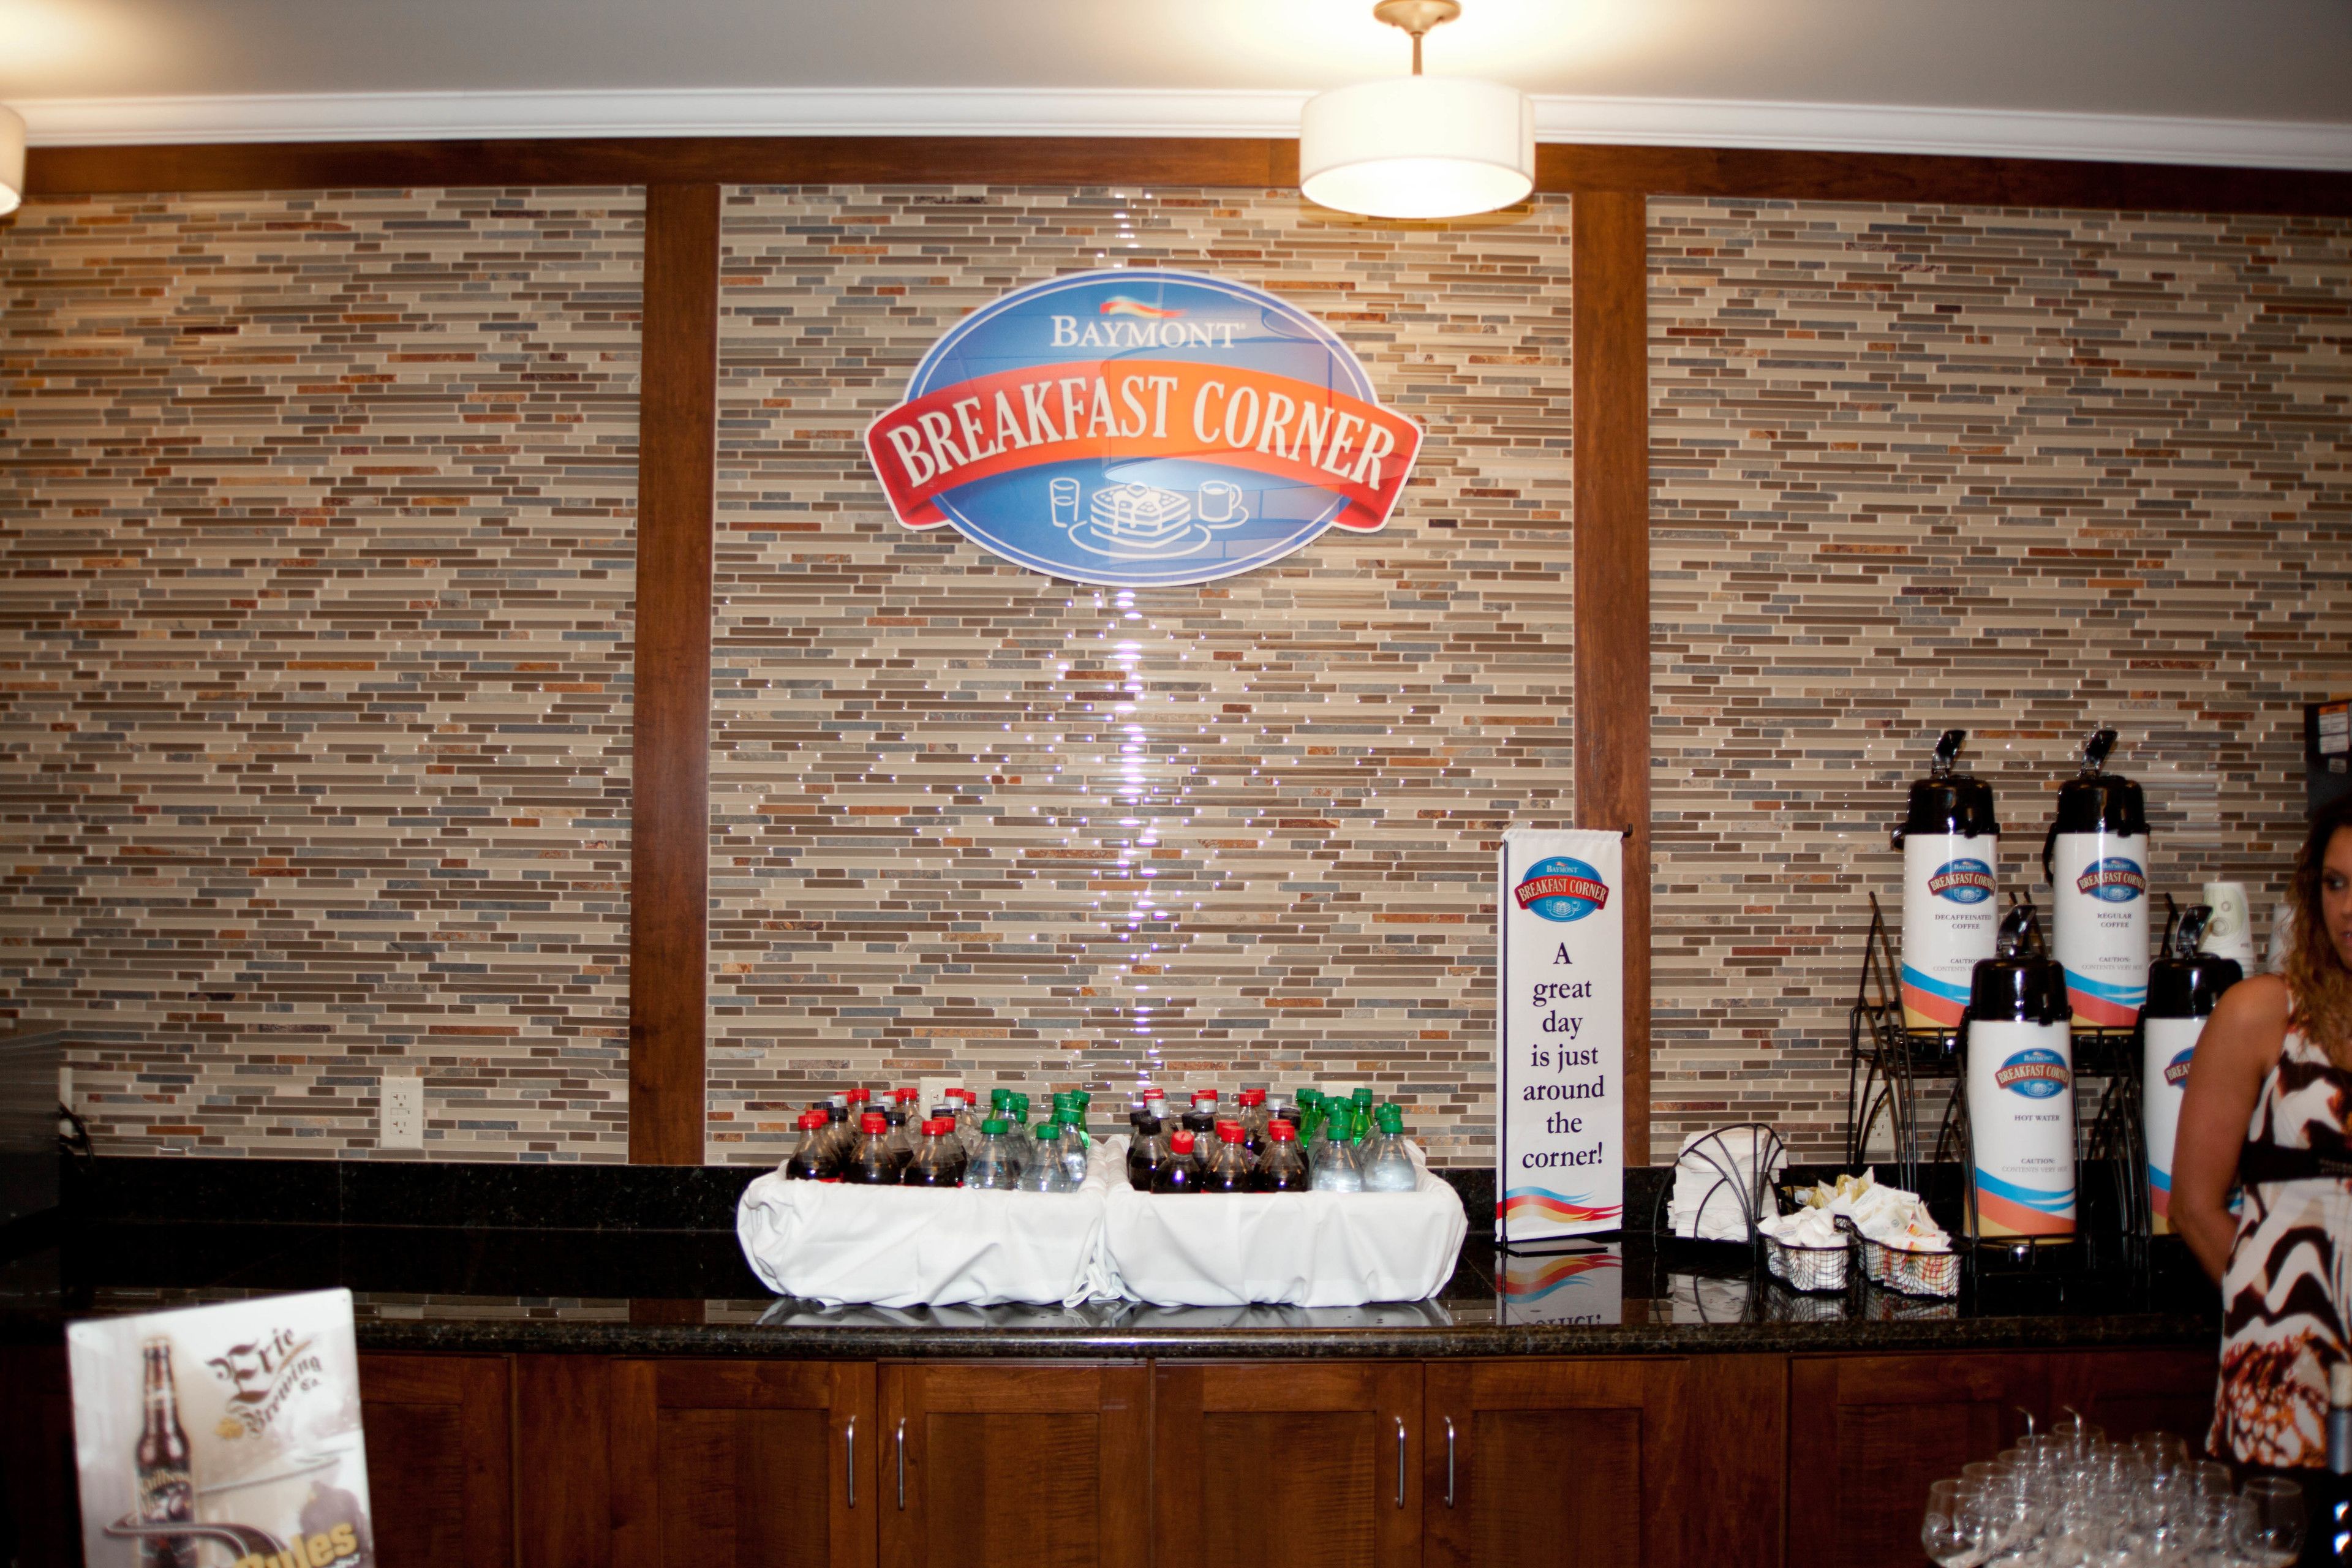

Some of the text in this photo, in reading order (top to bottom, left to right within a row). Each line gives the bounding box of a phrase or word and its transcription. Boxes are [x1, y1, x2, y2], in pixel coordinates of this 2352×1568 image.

[1051, 314, 1237, 349] BAYMONT
[887, 374, 1396, 491] BREAKFAST CORNER
[1546, 864, 1579, 874] BAYMONT
[2078, 872, 2146, 890] BREAKFAST CORNER
[1518, 878, 1607, 902] BREAKFAST CORNER
[1930, 873, 1995, 892] BREAKFAST CORNER
[1553, 942, 1573, 965] A
[1532, 979, 1592, 1007] great
[1542, 1010, 1583, 1040] day
[1531, 1043, 1599, 1074] is just
[1997, 1064, 2070, 1084] BREAKFAST CORNER
[1523, 1075, 1605, 1101] around
[1546, 1110, 1583, 1134] the
[1522, 1142, 1603, 1169] corner!
[205, 1328, 295, 1404] Erie
[236, 1355, 323, 1437] Brewing
